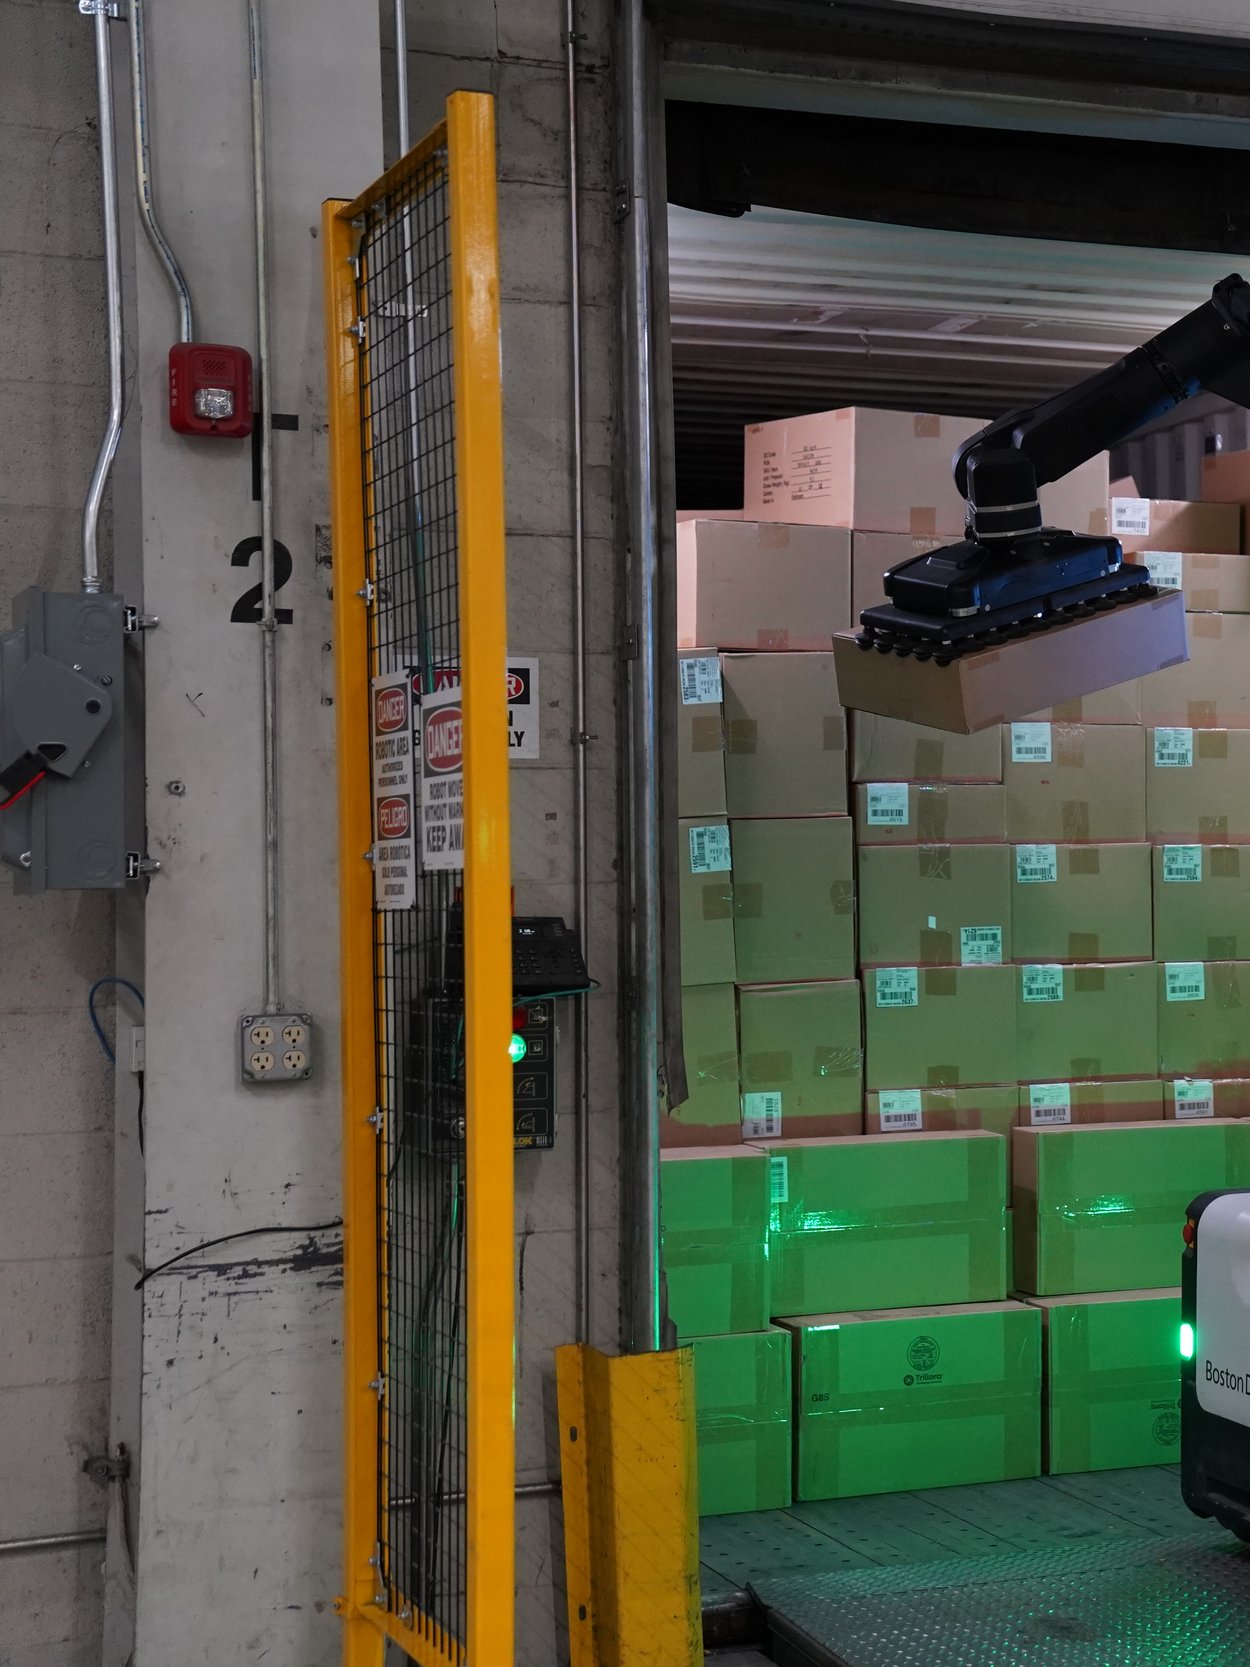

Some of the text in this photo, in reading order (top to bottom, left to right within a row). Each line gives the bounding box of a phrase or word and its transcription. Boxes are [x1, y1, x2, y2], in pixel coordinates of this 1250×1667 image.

[230, 536, 293, 624] 2
[378, 695, 405, 723] DANGER
[375, 738, 395, 760] ROBOTIC
[396, 736, 409, 757] AREA
[428, 719, 463, 759] DANGE
[399, 774, 408, 785] ONLY
[430, 781, 446, 800] ROBOT
[381, 806, 407, 828] PELIGRO
[424, 803, 447, 822] WITHOUT
[427, 825, 446, 853] KEEP
